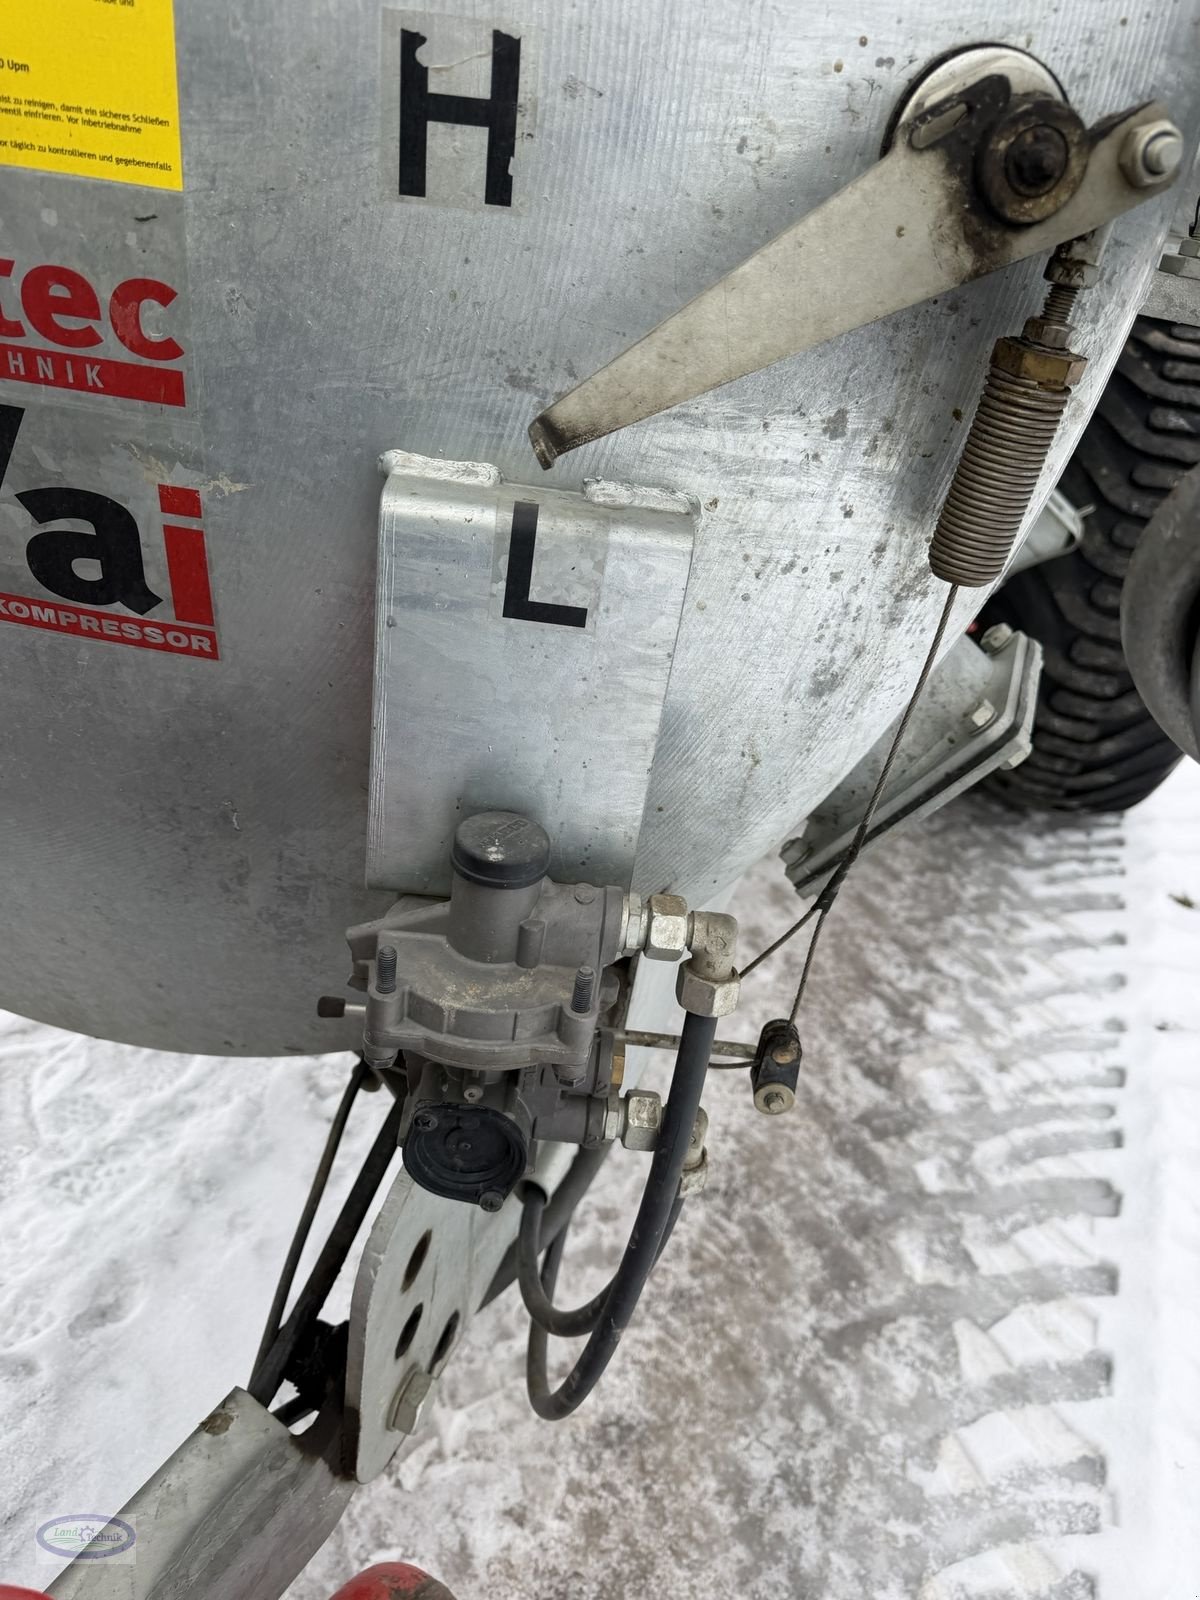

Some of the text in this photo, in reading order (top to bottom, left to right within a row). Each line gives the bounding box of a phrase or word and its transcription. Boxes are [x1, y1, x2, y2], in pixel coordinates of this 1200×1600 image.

[7, 59, 30, 73] Upm
[13, 98, 22, 106] zu
[24, 98, 58, 112] reinigen,
[60, 102, 83, 115] damit
[84, 107, 97, 116] ein
[99, 109, 130, 122] sicheres
[132, 113, 170, 127] Schließen
[23, 109, 64, 123] einfrieren.
[66, 114, 79, 125] Vor
[81, 117, 142, 135] Inbetriebnahme
[398, 28, 521, 207] H
[10, 140, 36, 152] täglich
[37, 145, 46, 153] zu
[48, 145, 97, 161] kontrollieren
[99, 153, 113, 163] und
[115, 157, 172, 172] gegebenenfalls
[0, 404, 215, 627] ai
[502, 501, 588, 628] L
